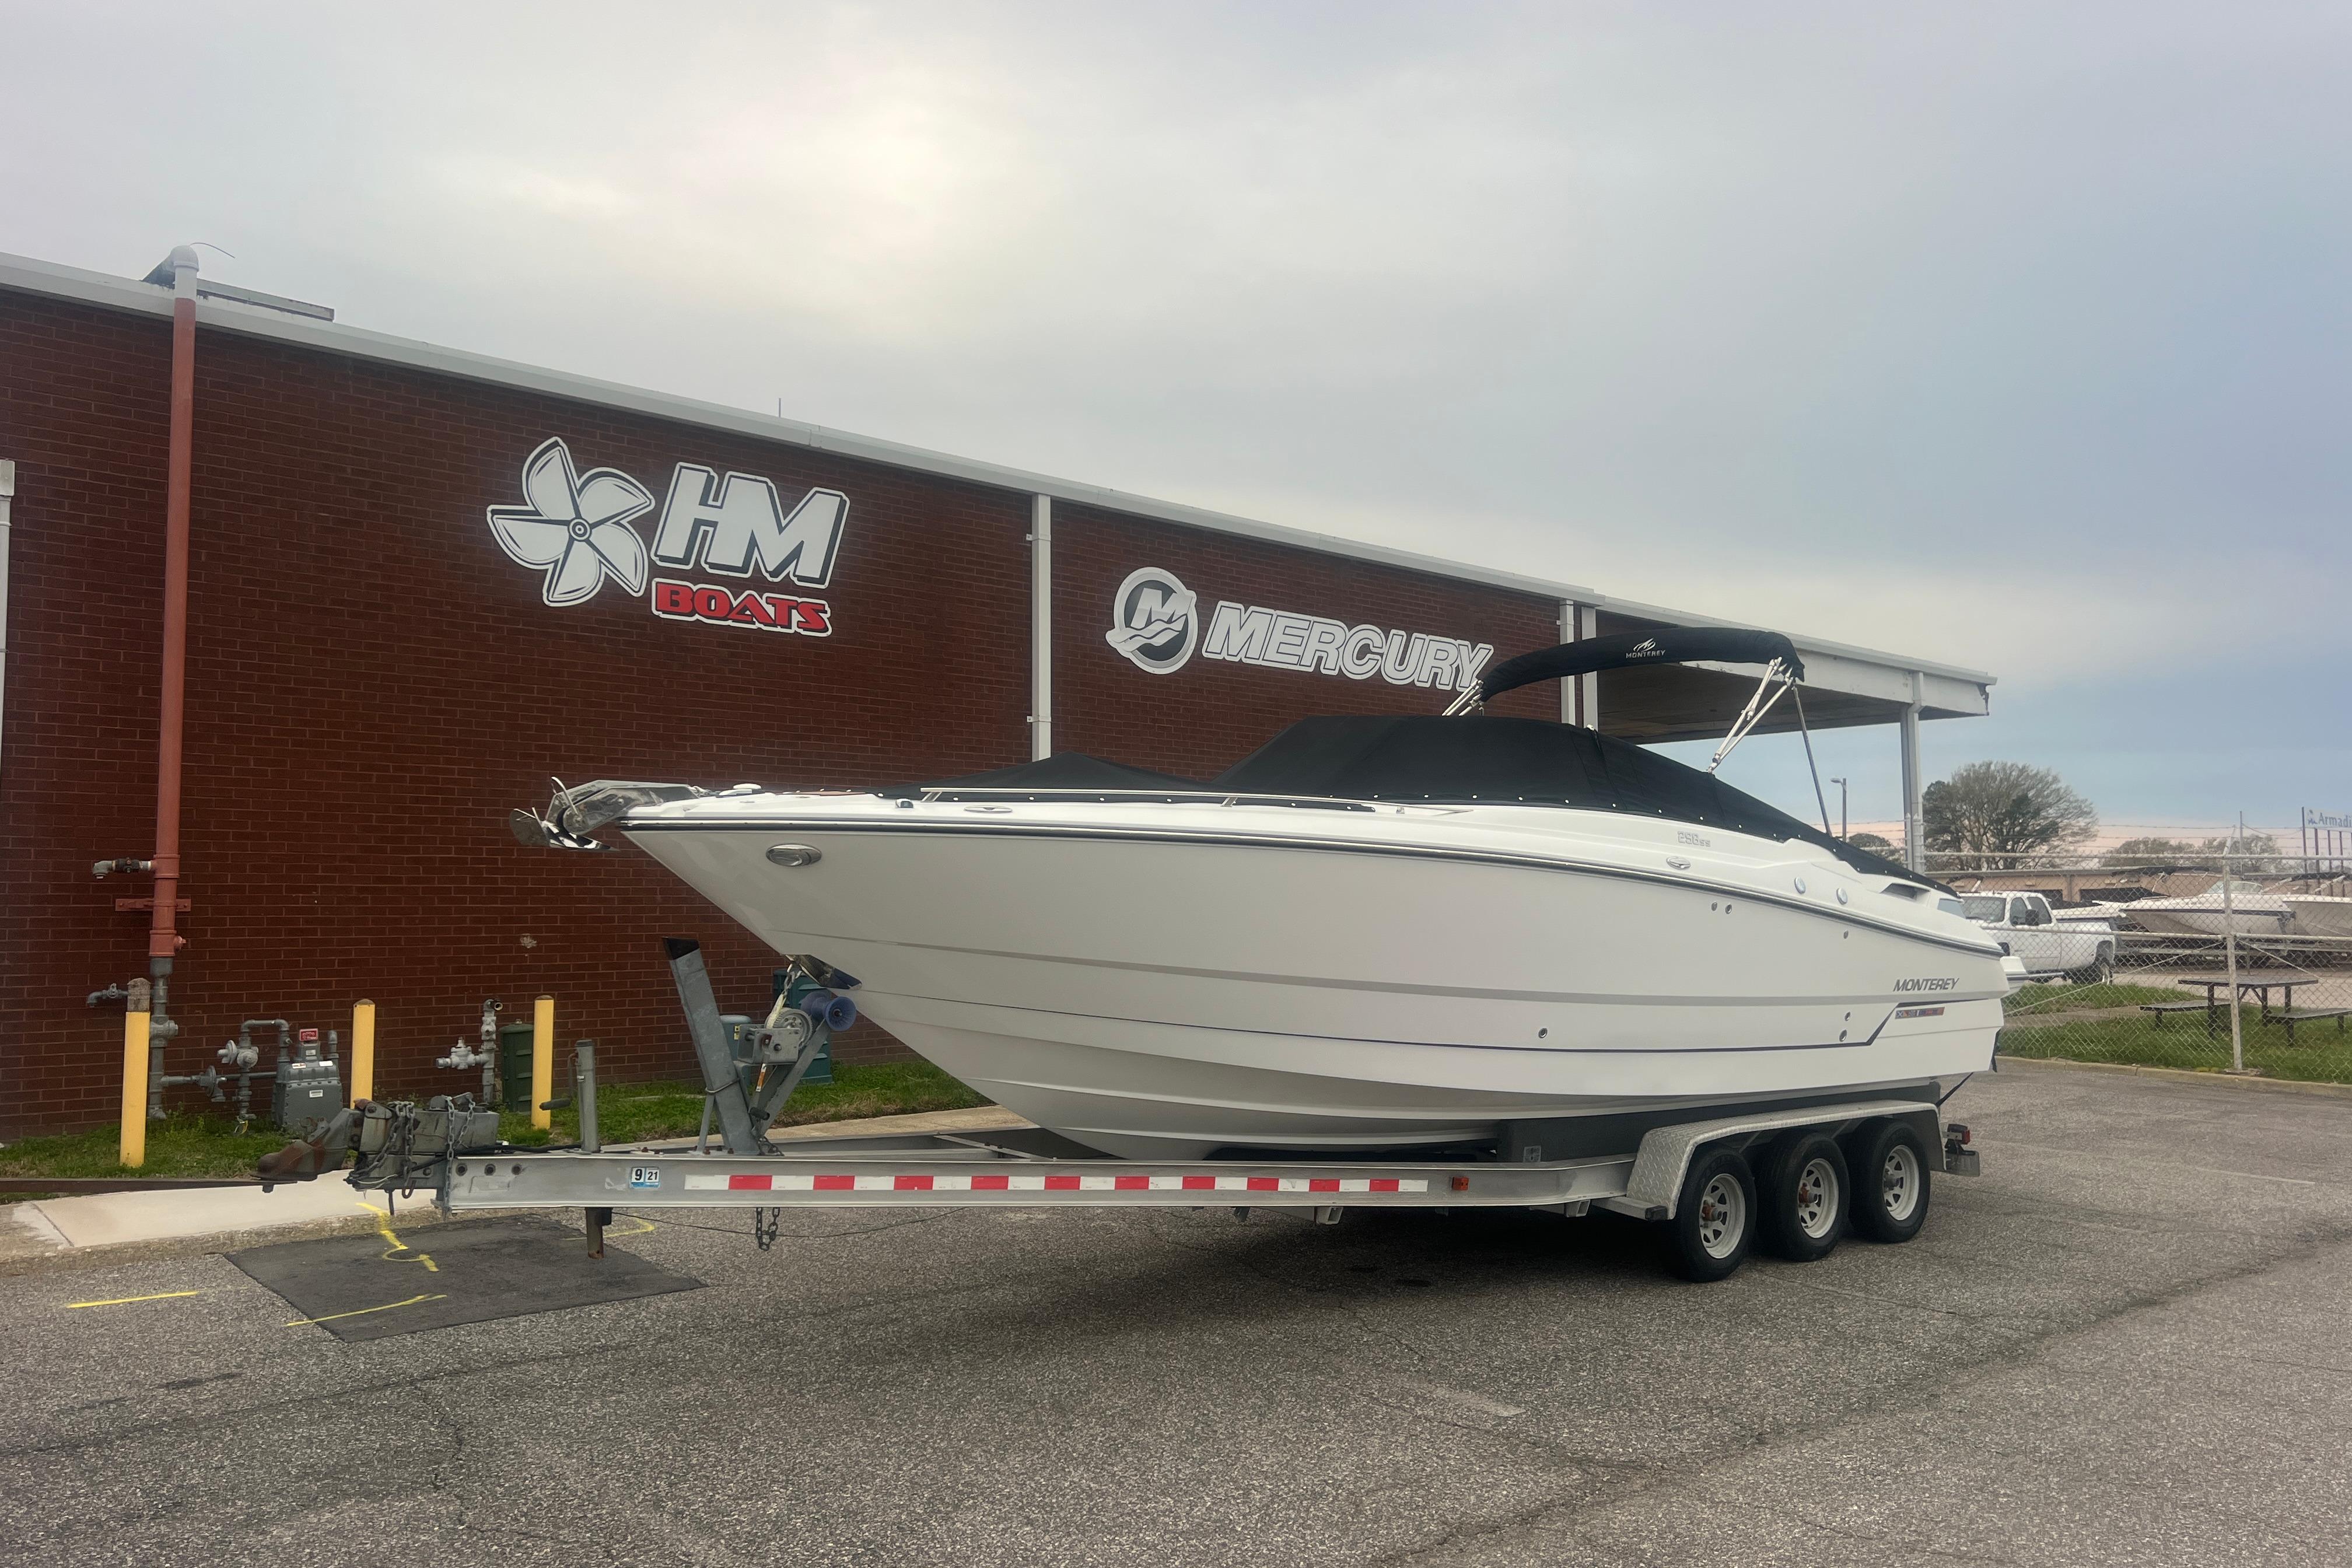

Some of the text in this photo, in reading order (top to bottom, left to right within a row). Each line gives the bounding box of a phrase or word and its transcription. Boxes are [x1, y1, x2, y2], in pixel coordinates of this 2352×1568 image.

[654, 467, 848, 586] HM
[656, 583, 830, 633] BOATS
[1206, 603, 1490, 690] MERCURY
[2319, 812, 2352, 827] Armadi
[1893, 977, 1960, 992] MONTEREY
[635, 1168, 658, 1181] 9 21
